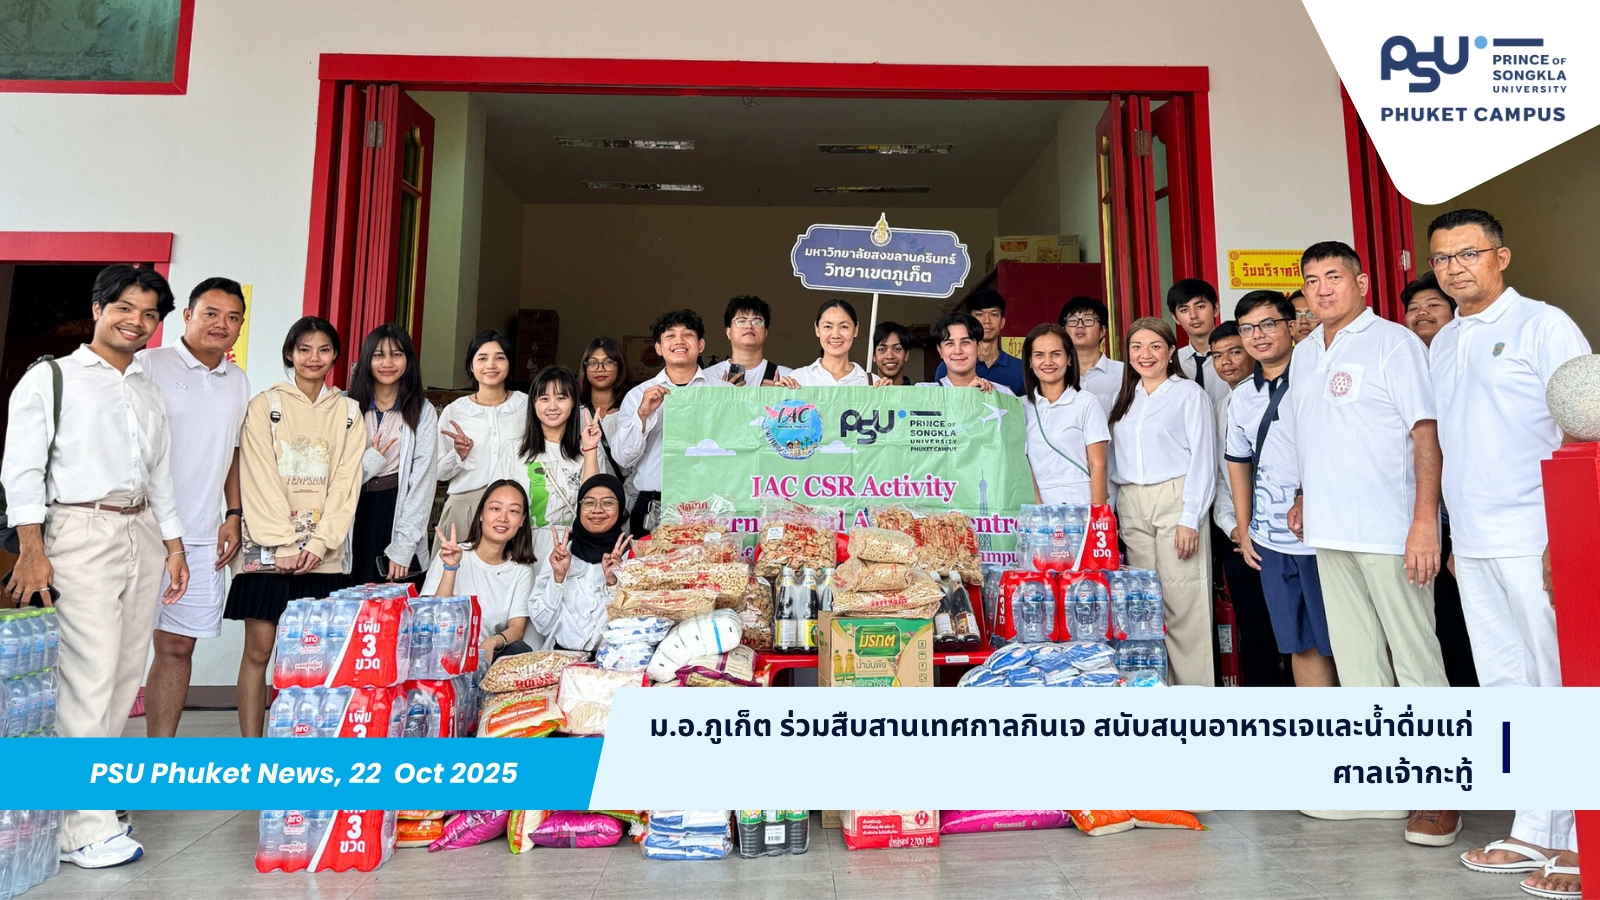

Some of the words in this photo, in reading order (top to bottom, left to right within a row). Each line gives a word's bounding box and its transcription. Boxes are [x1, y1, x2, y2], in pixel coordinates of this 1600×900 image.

[804, 247, 957, 265] มหาวิทยาลัยสงขลานครินทร์
[824, 263, 932, 286] วิทยาเขตภูเก็ต
[1242, 259, 1301, 277] รับบริจาคสิ่
[840, 409, 895, 445] PSU
[910, 420, 946, 428] PRINCE
[910, 429, 957, 437] SONGKLA
[752, 476, 797, 498] IAC
[804, 475, 857, 498] CSR
[861, 474, 957, 502] Activity
[1096, 531, 1107, 548] 3
[1092, 548, 1112, 558] ขวด
[358, 617, 381, 634] เพิ่ม
[361, 634, 377, 657] 3
[858, 634, 897, 649] มรกต
[355, 657, 381, 671] ขวด
[856, 659, 887, 669] น้ำมันพืช
[348, 706, 372, 724] เพิ่ม
[294, 725, 310, 733] aro
[287, 815, 303, 823] aro
[346, 814, 363, 839] 3
[340, 840, 366, 853] ขวด
